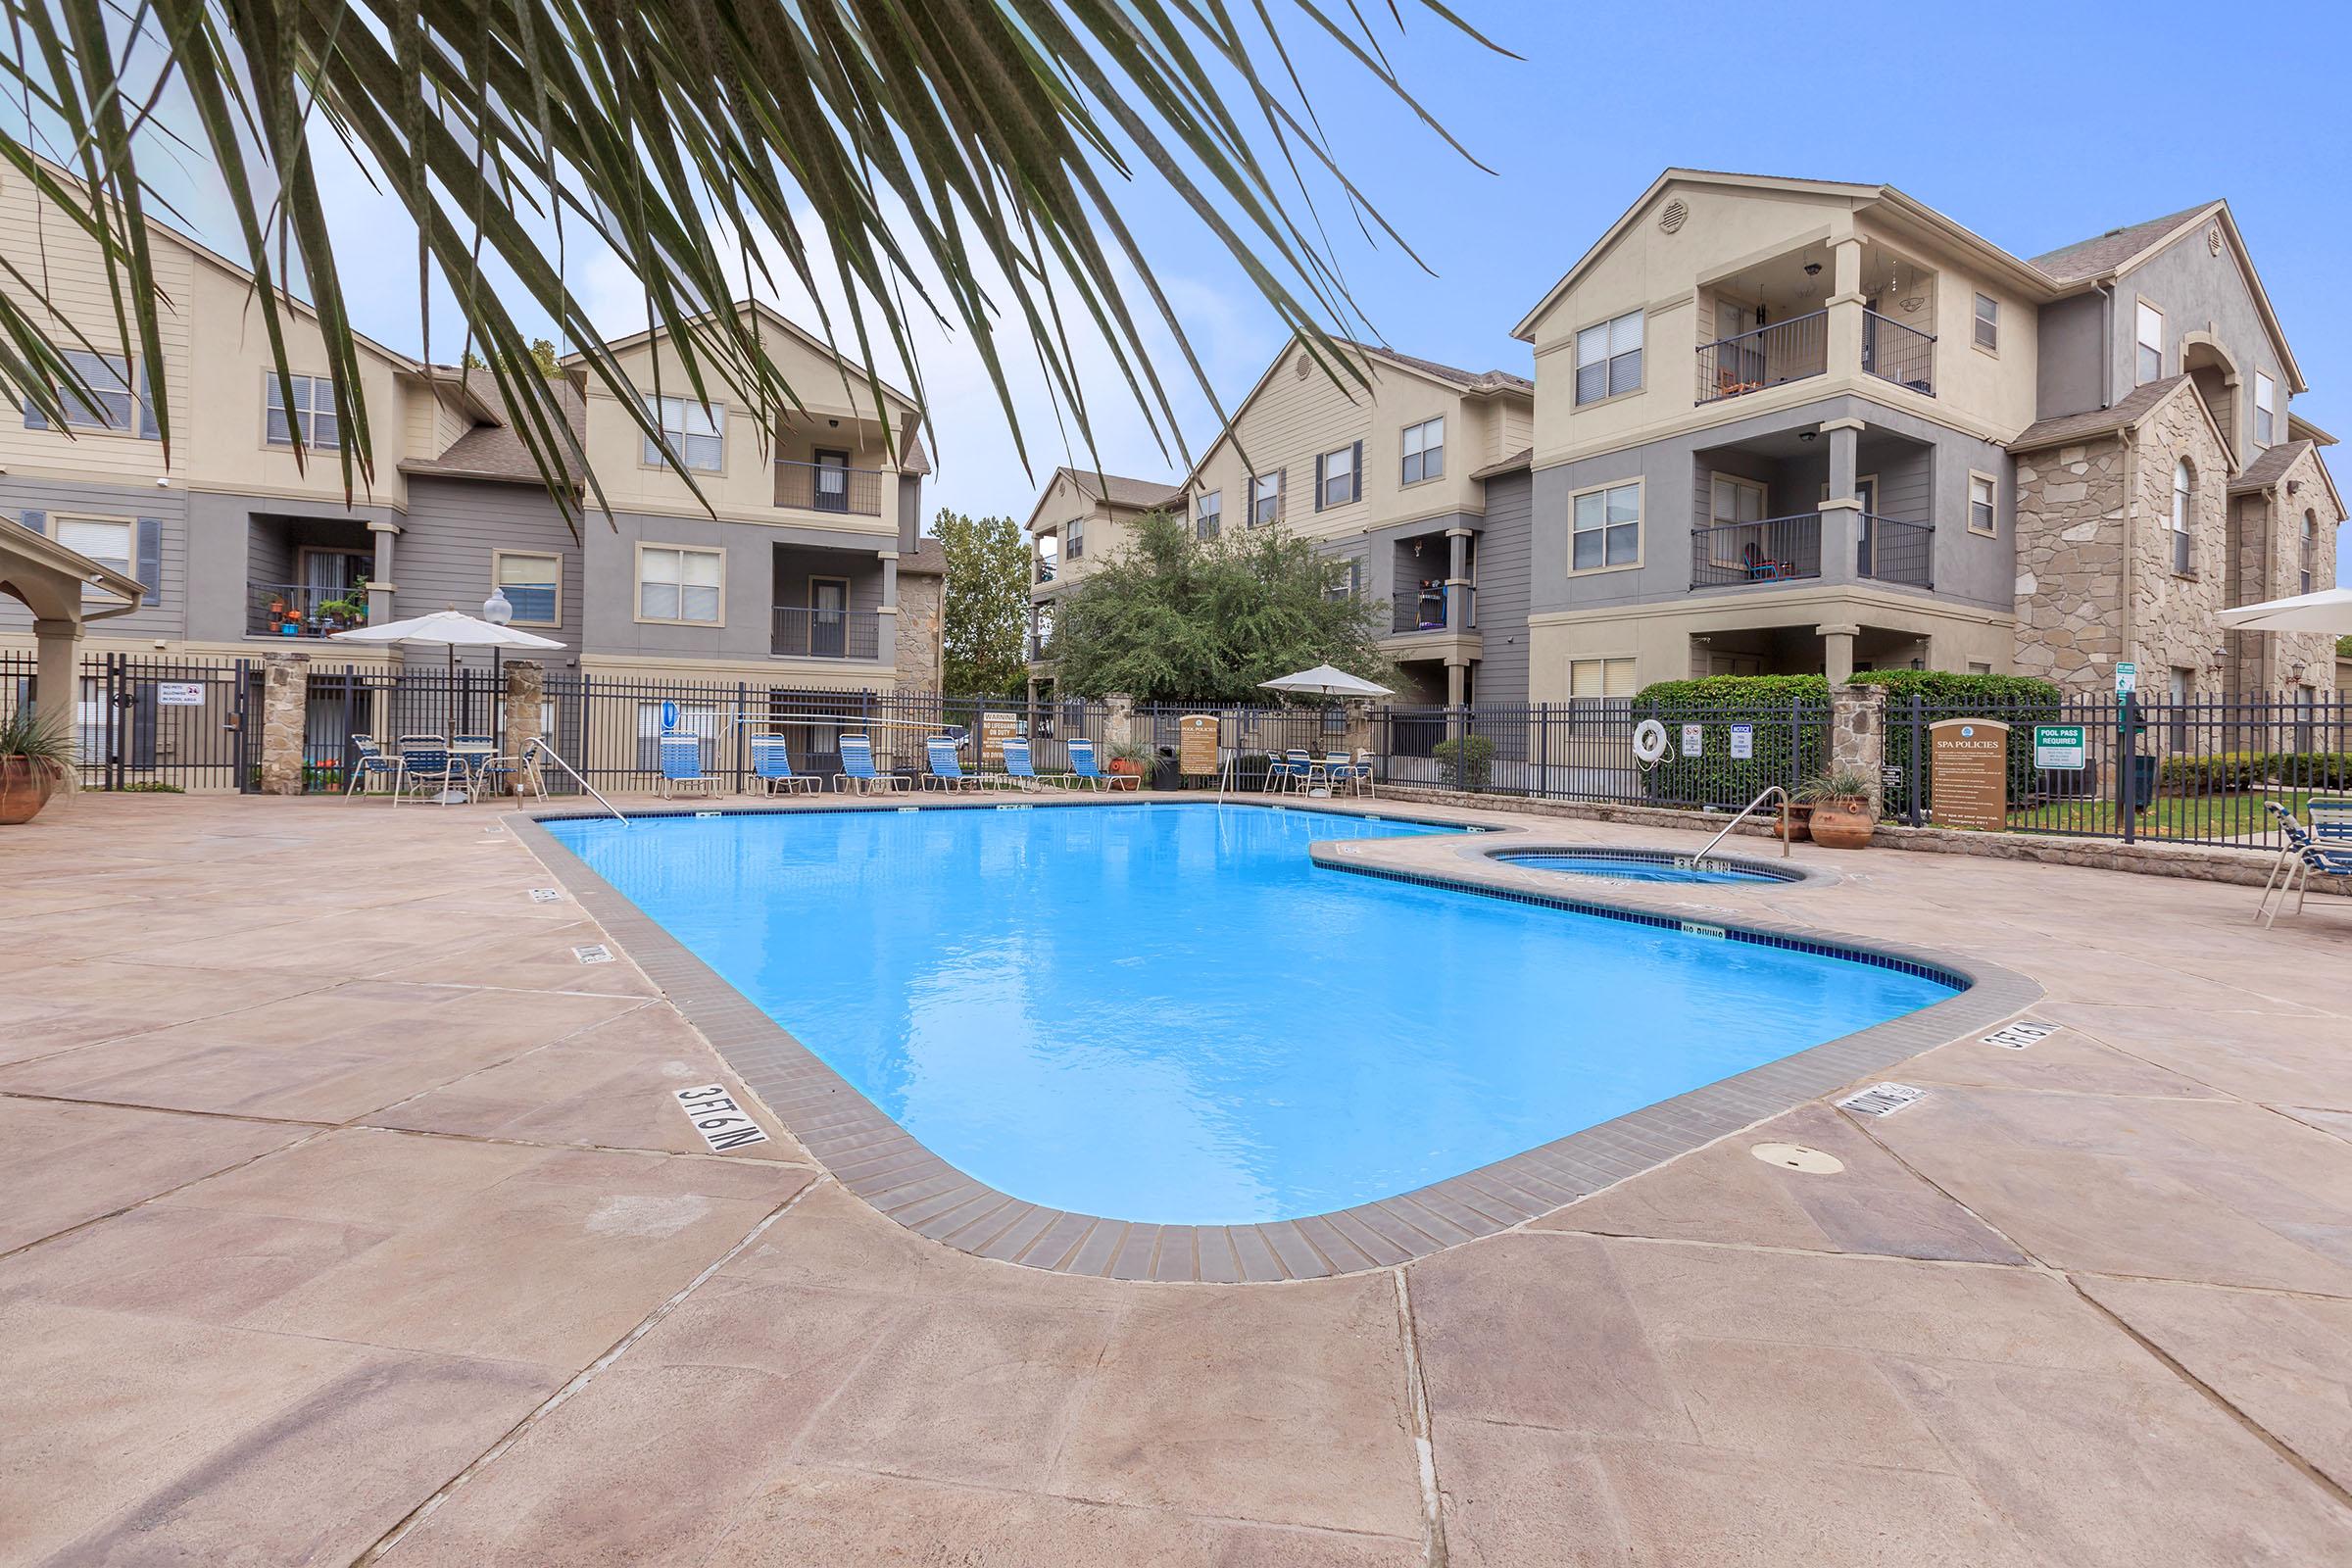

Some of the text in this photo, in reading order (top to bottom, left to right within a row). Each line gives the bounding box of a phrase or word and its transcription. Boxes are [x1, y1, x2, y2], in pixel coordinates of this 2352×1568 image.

[1679, 858, 1686, 869] 3
[1706, 860, 1714, 871] 6
[1719, 862, 1729, 871] IN
[1993, 1031, 2037, 1044] FT
[2012, 1027, 2047, 1036] 6
[1984, 1039, 2023, 1048] 3
[678, 1088, 765, 1151] 3 FT 6 IN
